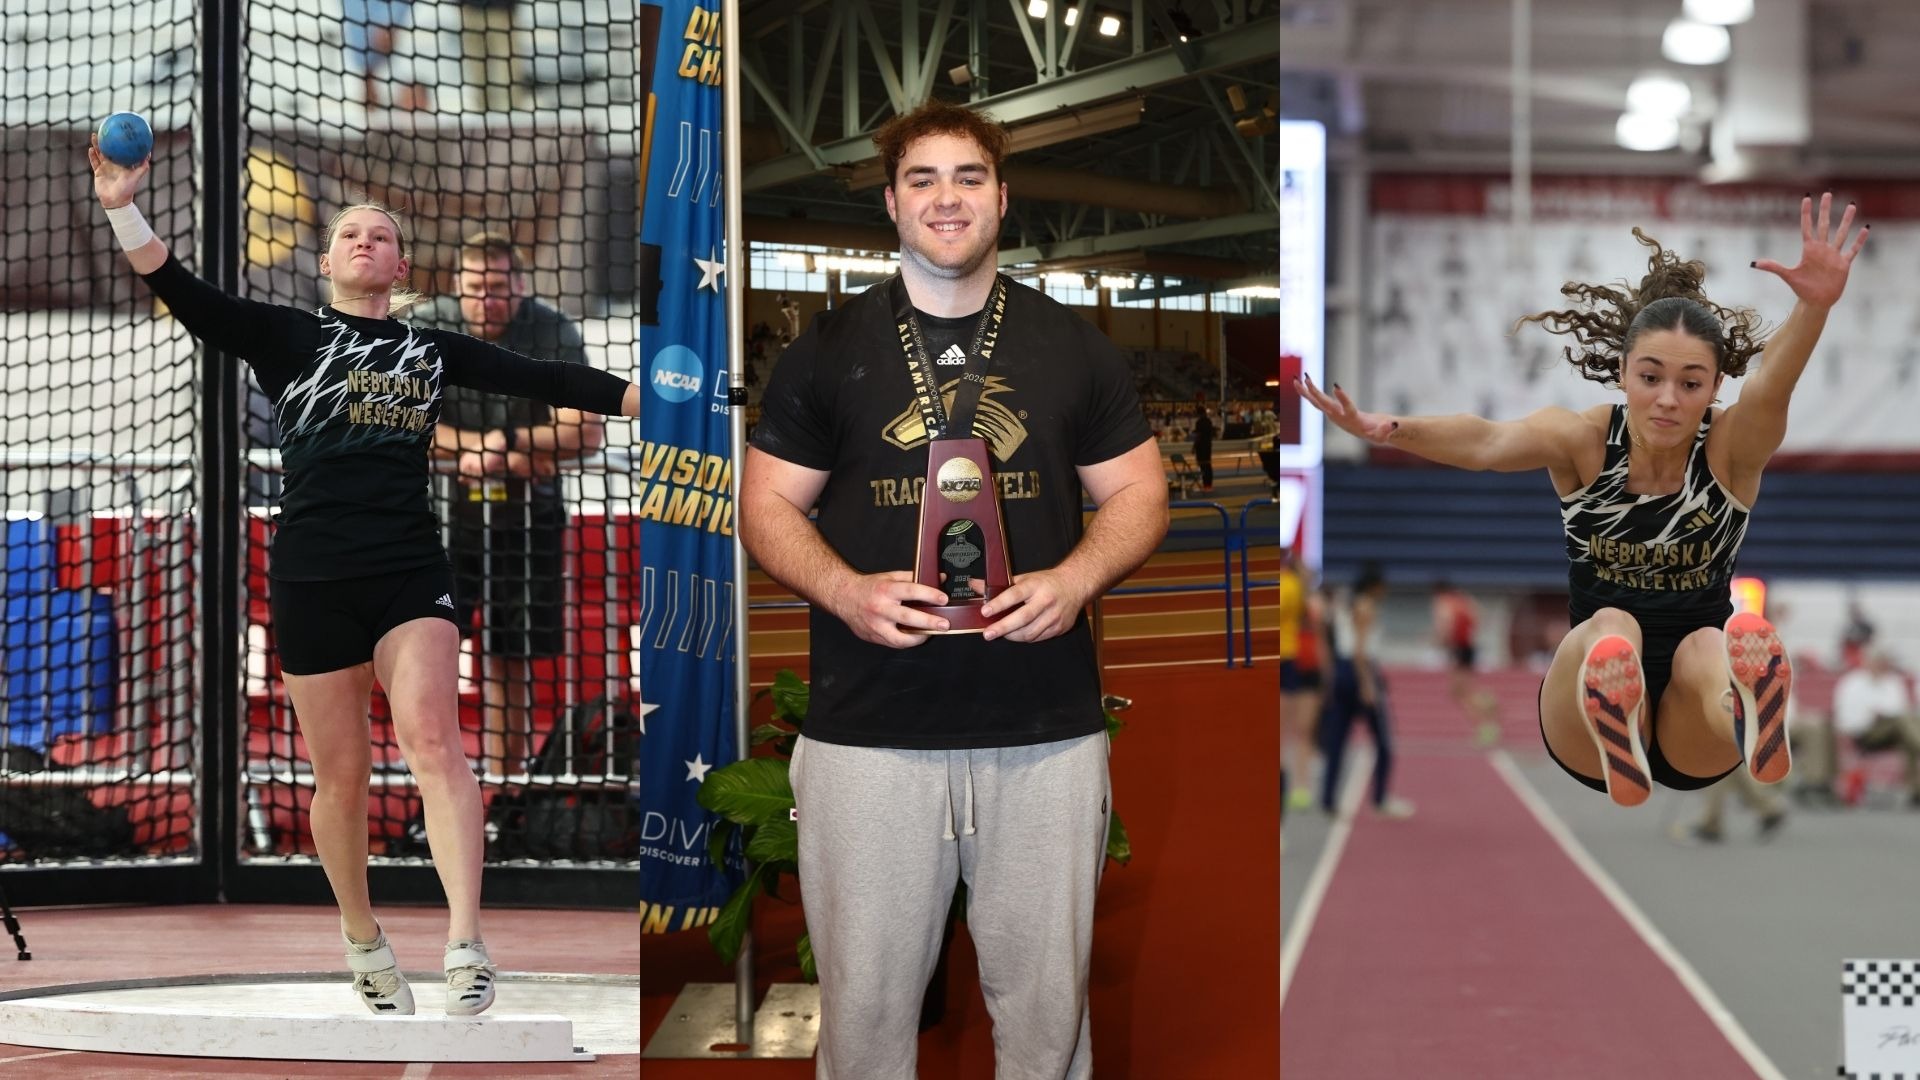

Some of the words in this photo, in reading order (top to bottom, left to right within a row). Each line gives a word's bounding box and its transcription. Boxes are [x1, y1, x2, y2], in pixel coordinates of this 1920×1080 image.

[936, 357, 966, 366] adida
[347, 370, 432, 402] NEBRASKA
[654, 369, 700, 392] NCAA
[925, 372, 939, 401] INDOOR
[963, 372, 985, 383] 2026
[348, 402, 429, 431] WESLEYAN
[711, 402, 730, 415] DIS
[870, 477, 926, 507] TRAC
[940, 478, 982, 492] NCAA
[1590, 533, 1712, 566] NEBRASKA
[640, 846, 700, 867] DISCOVER
